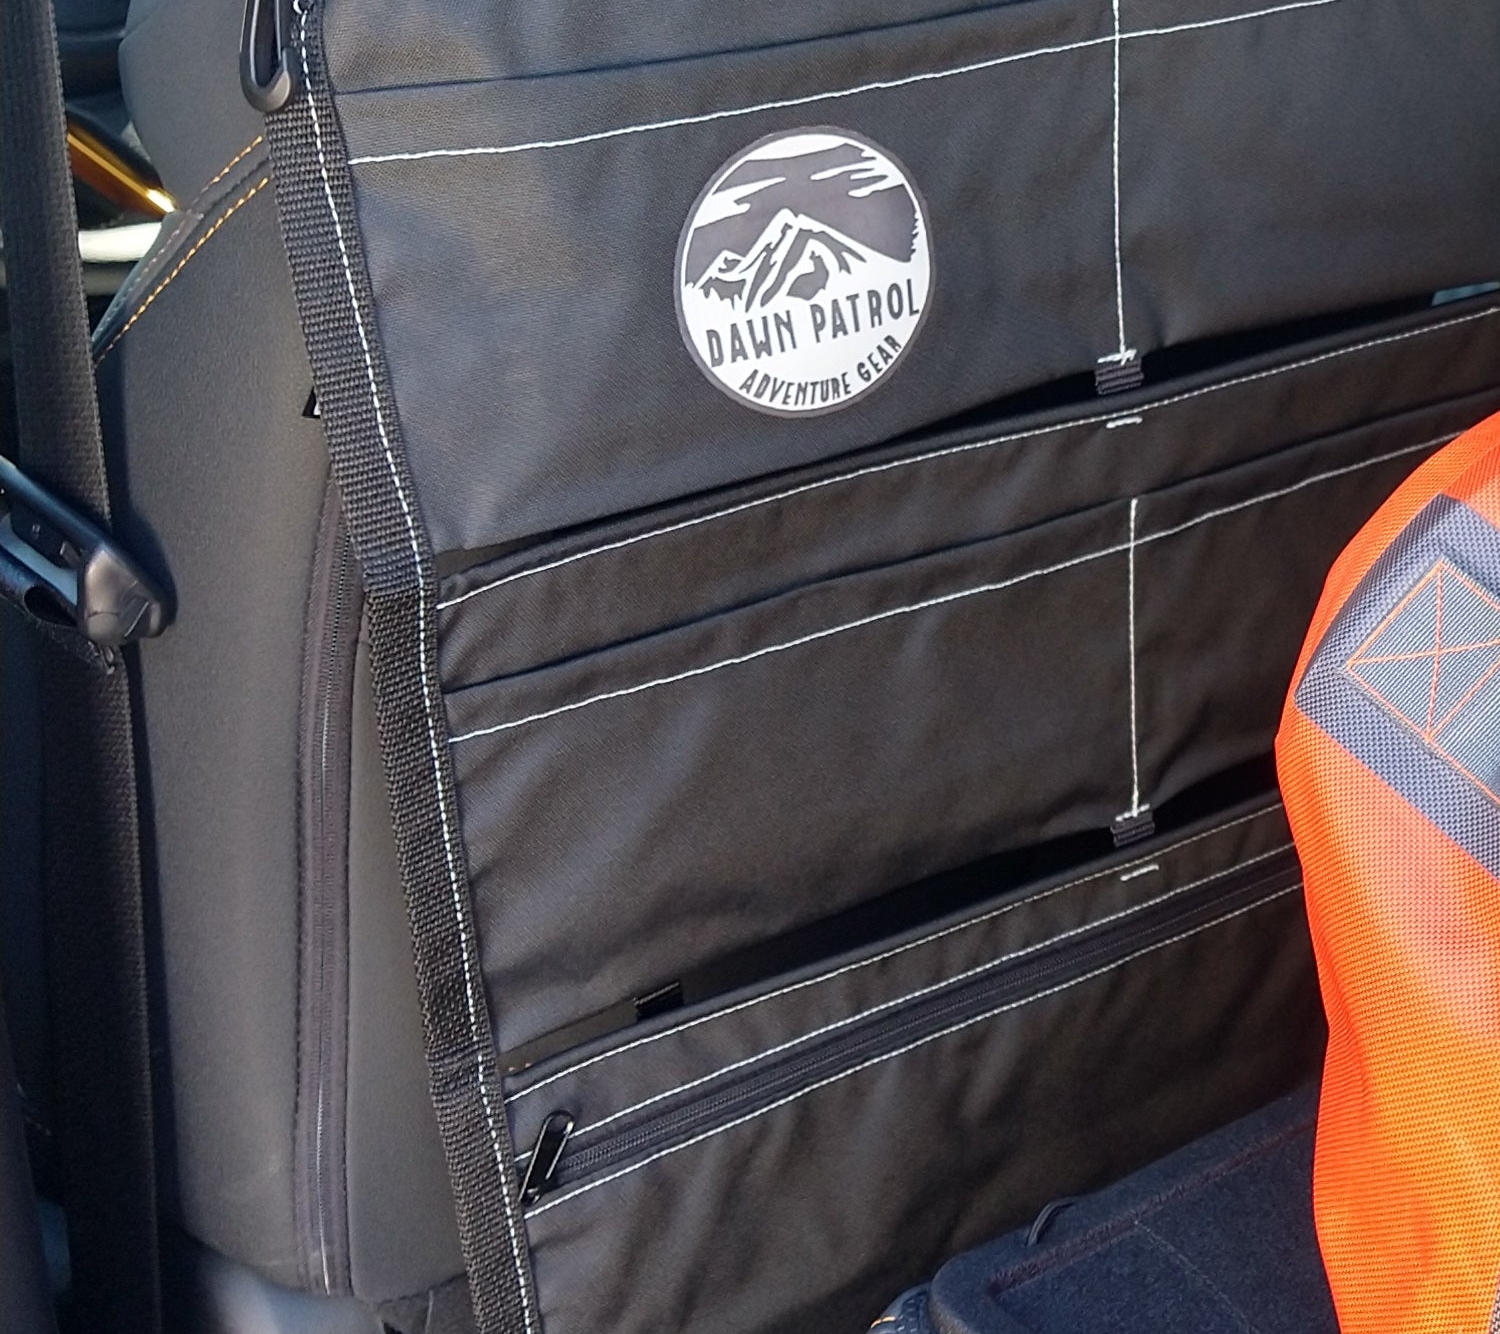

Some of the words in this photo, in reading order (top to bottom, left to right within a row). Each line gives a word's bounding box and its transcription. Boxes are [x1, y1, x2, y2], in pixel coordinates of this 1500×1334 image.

[706, 310, 797, 367] DAWN
[810, 278, 920, 343] PATROL
[738, 369, 852, 406] ADVENTURE
[856, 334, 902, 382] GEAR
